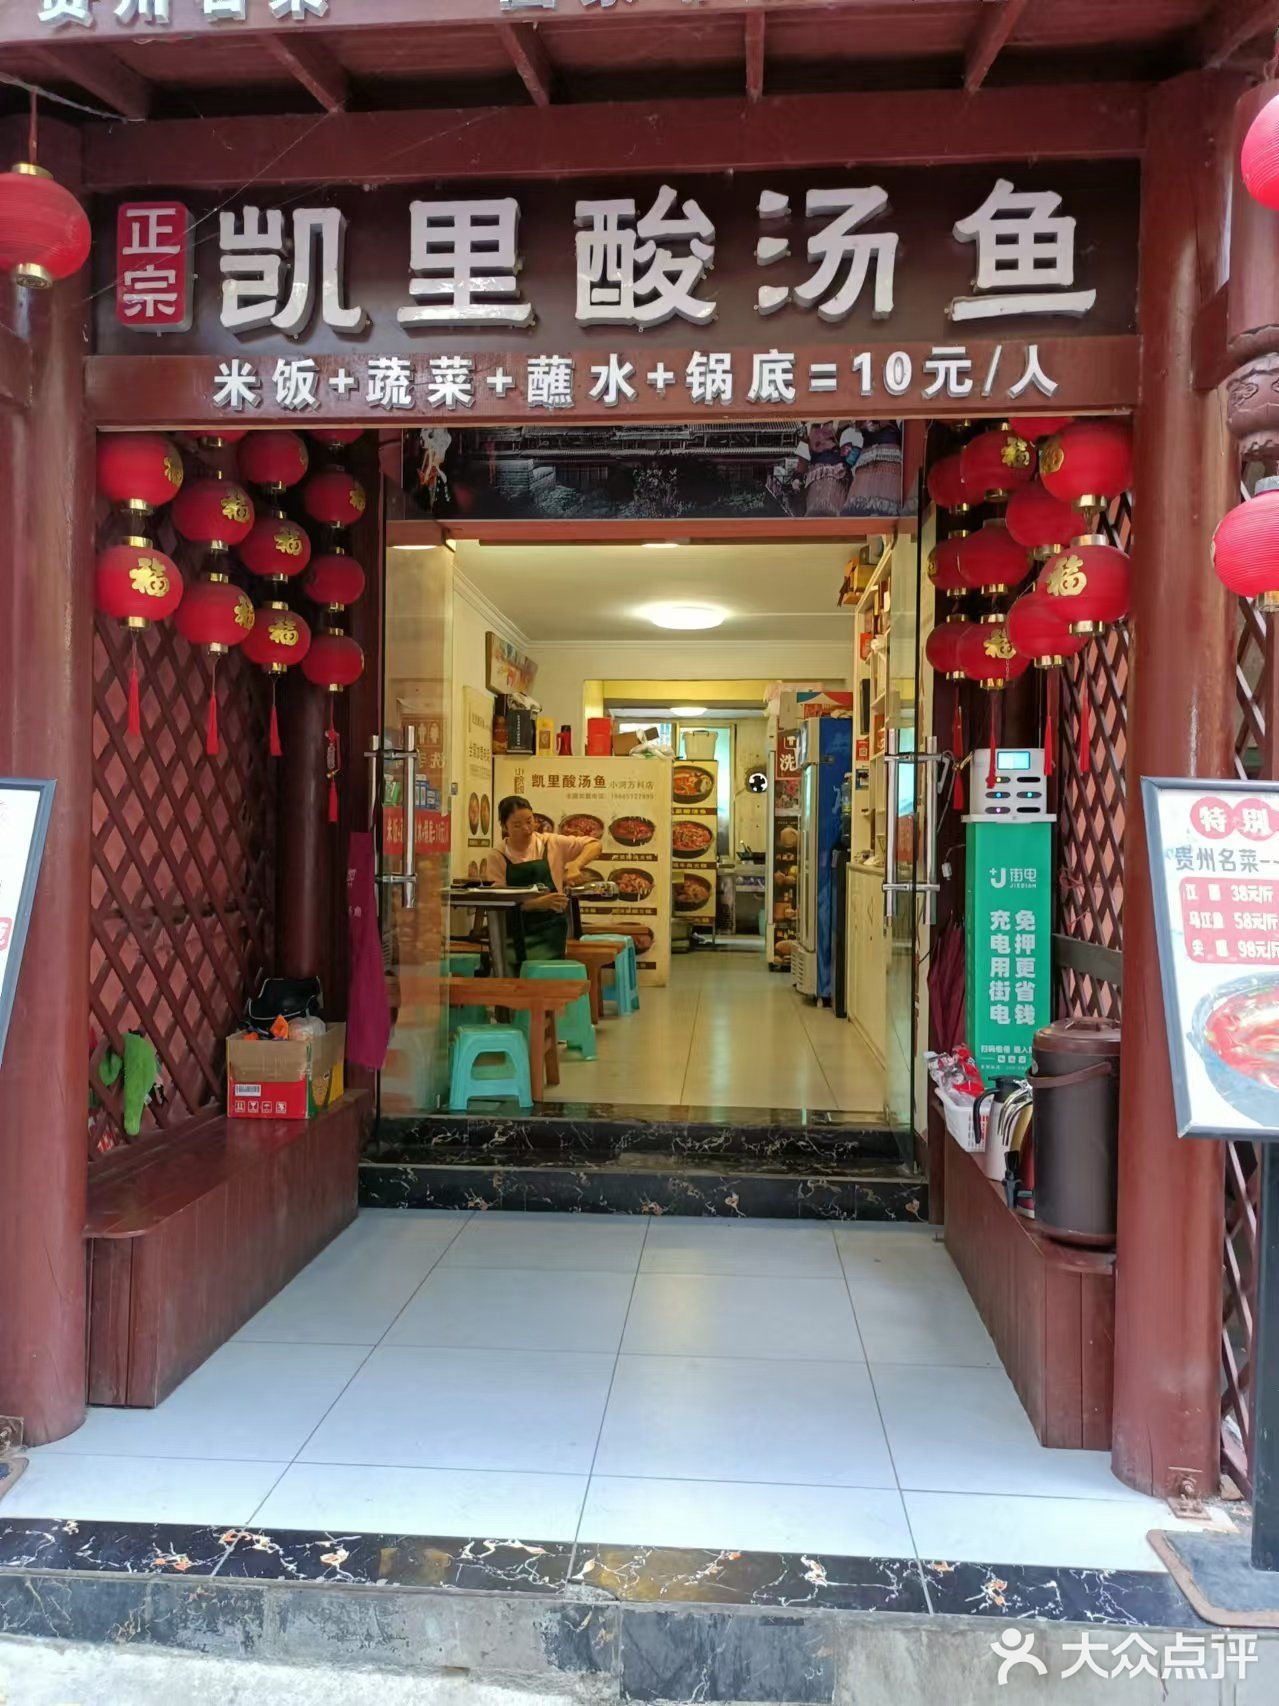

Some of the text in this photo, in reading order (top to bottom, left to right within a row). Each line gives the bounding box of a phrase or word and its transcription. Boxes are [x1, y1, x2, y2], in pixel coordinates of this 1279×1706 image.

[122, 208, 181, 318] 正宗
[219, 178, 1097, 336] 凯里酸汤鱼
[531, 774, 607, 788] 凯里酸汤鱼
[1010, 868, 1036, 882] 街电
[989, 910, 1011, 1025] 充电用街电
[1015, 910, 1036, 1025] 免押更省钱
